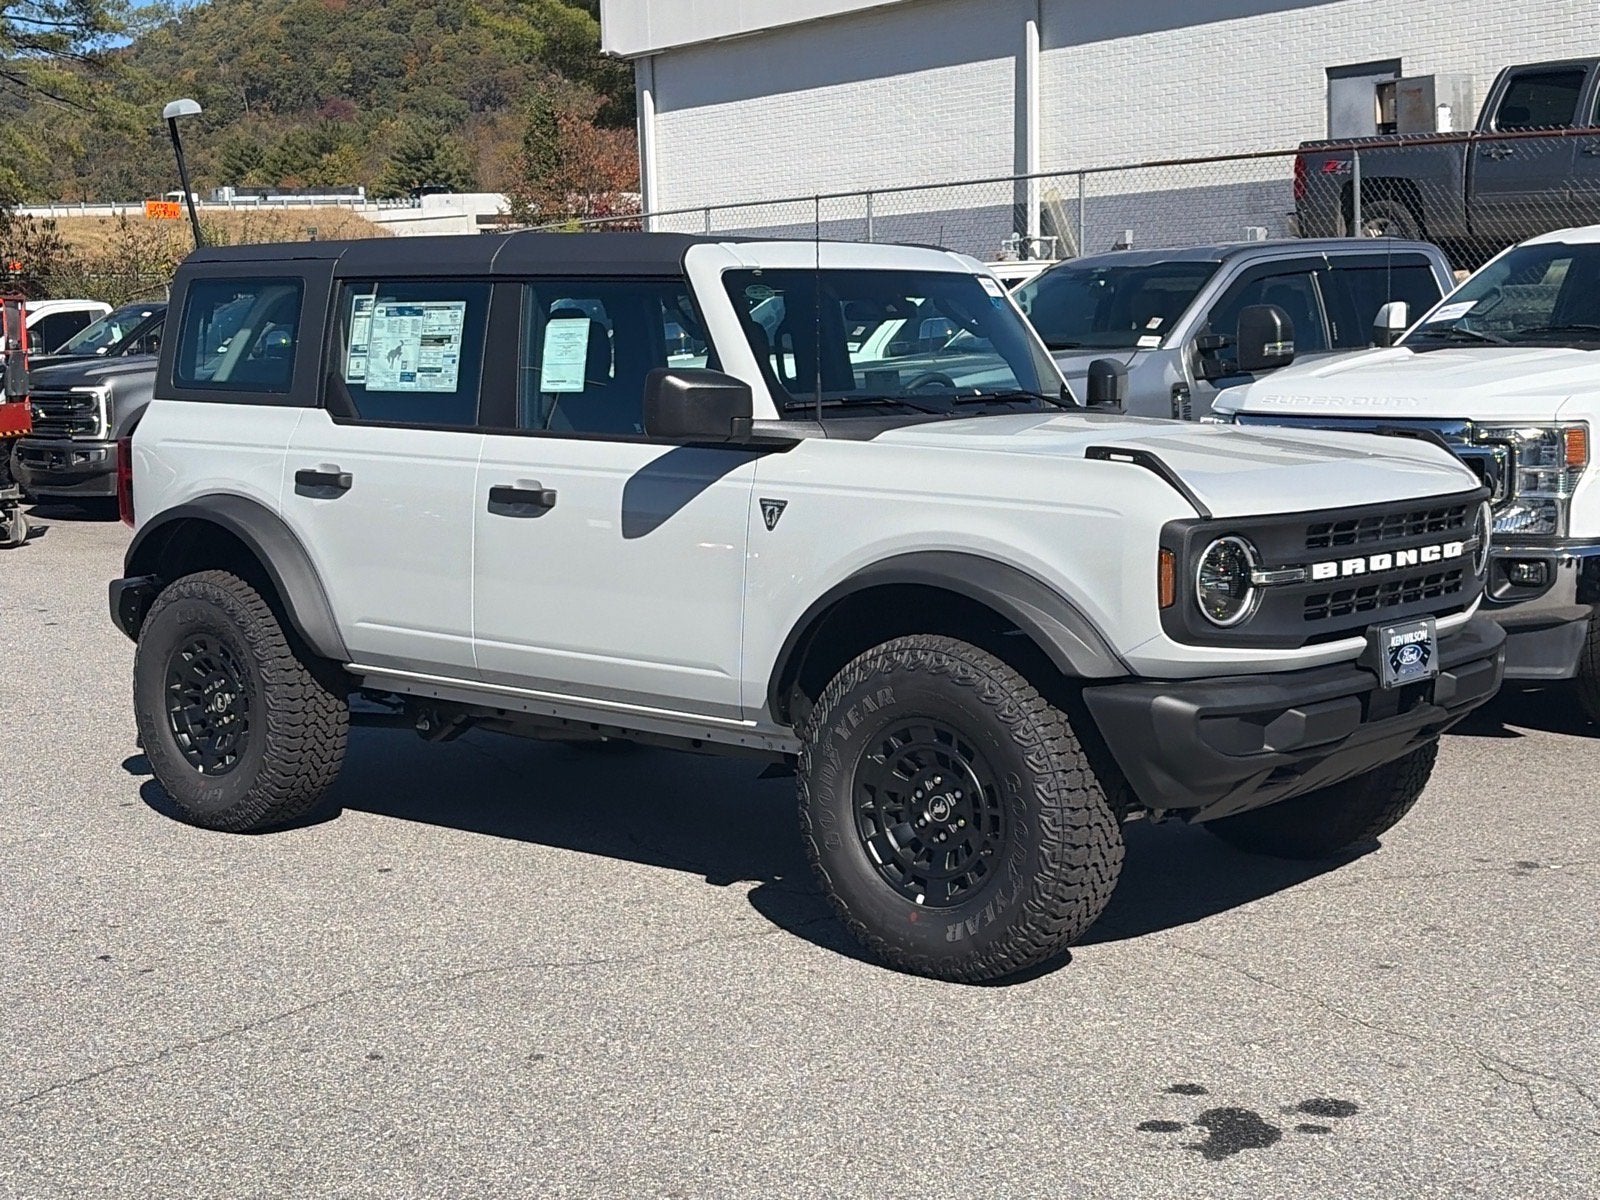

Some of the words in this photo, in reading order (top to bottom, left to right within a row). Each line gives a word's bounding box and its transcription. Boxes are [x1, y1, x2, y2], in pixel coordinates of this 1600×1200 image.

[1261, 394, 1346, 406] SUPER
[1347, 396, 1421, 407] DUTY
[1312, 541, 1463, 580] BRONCO
